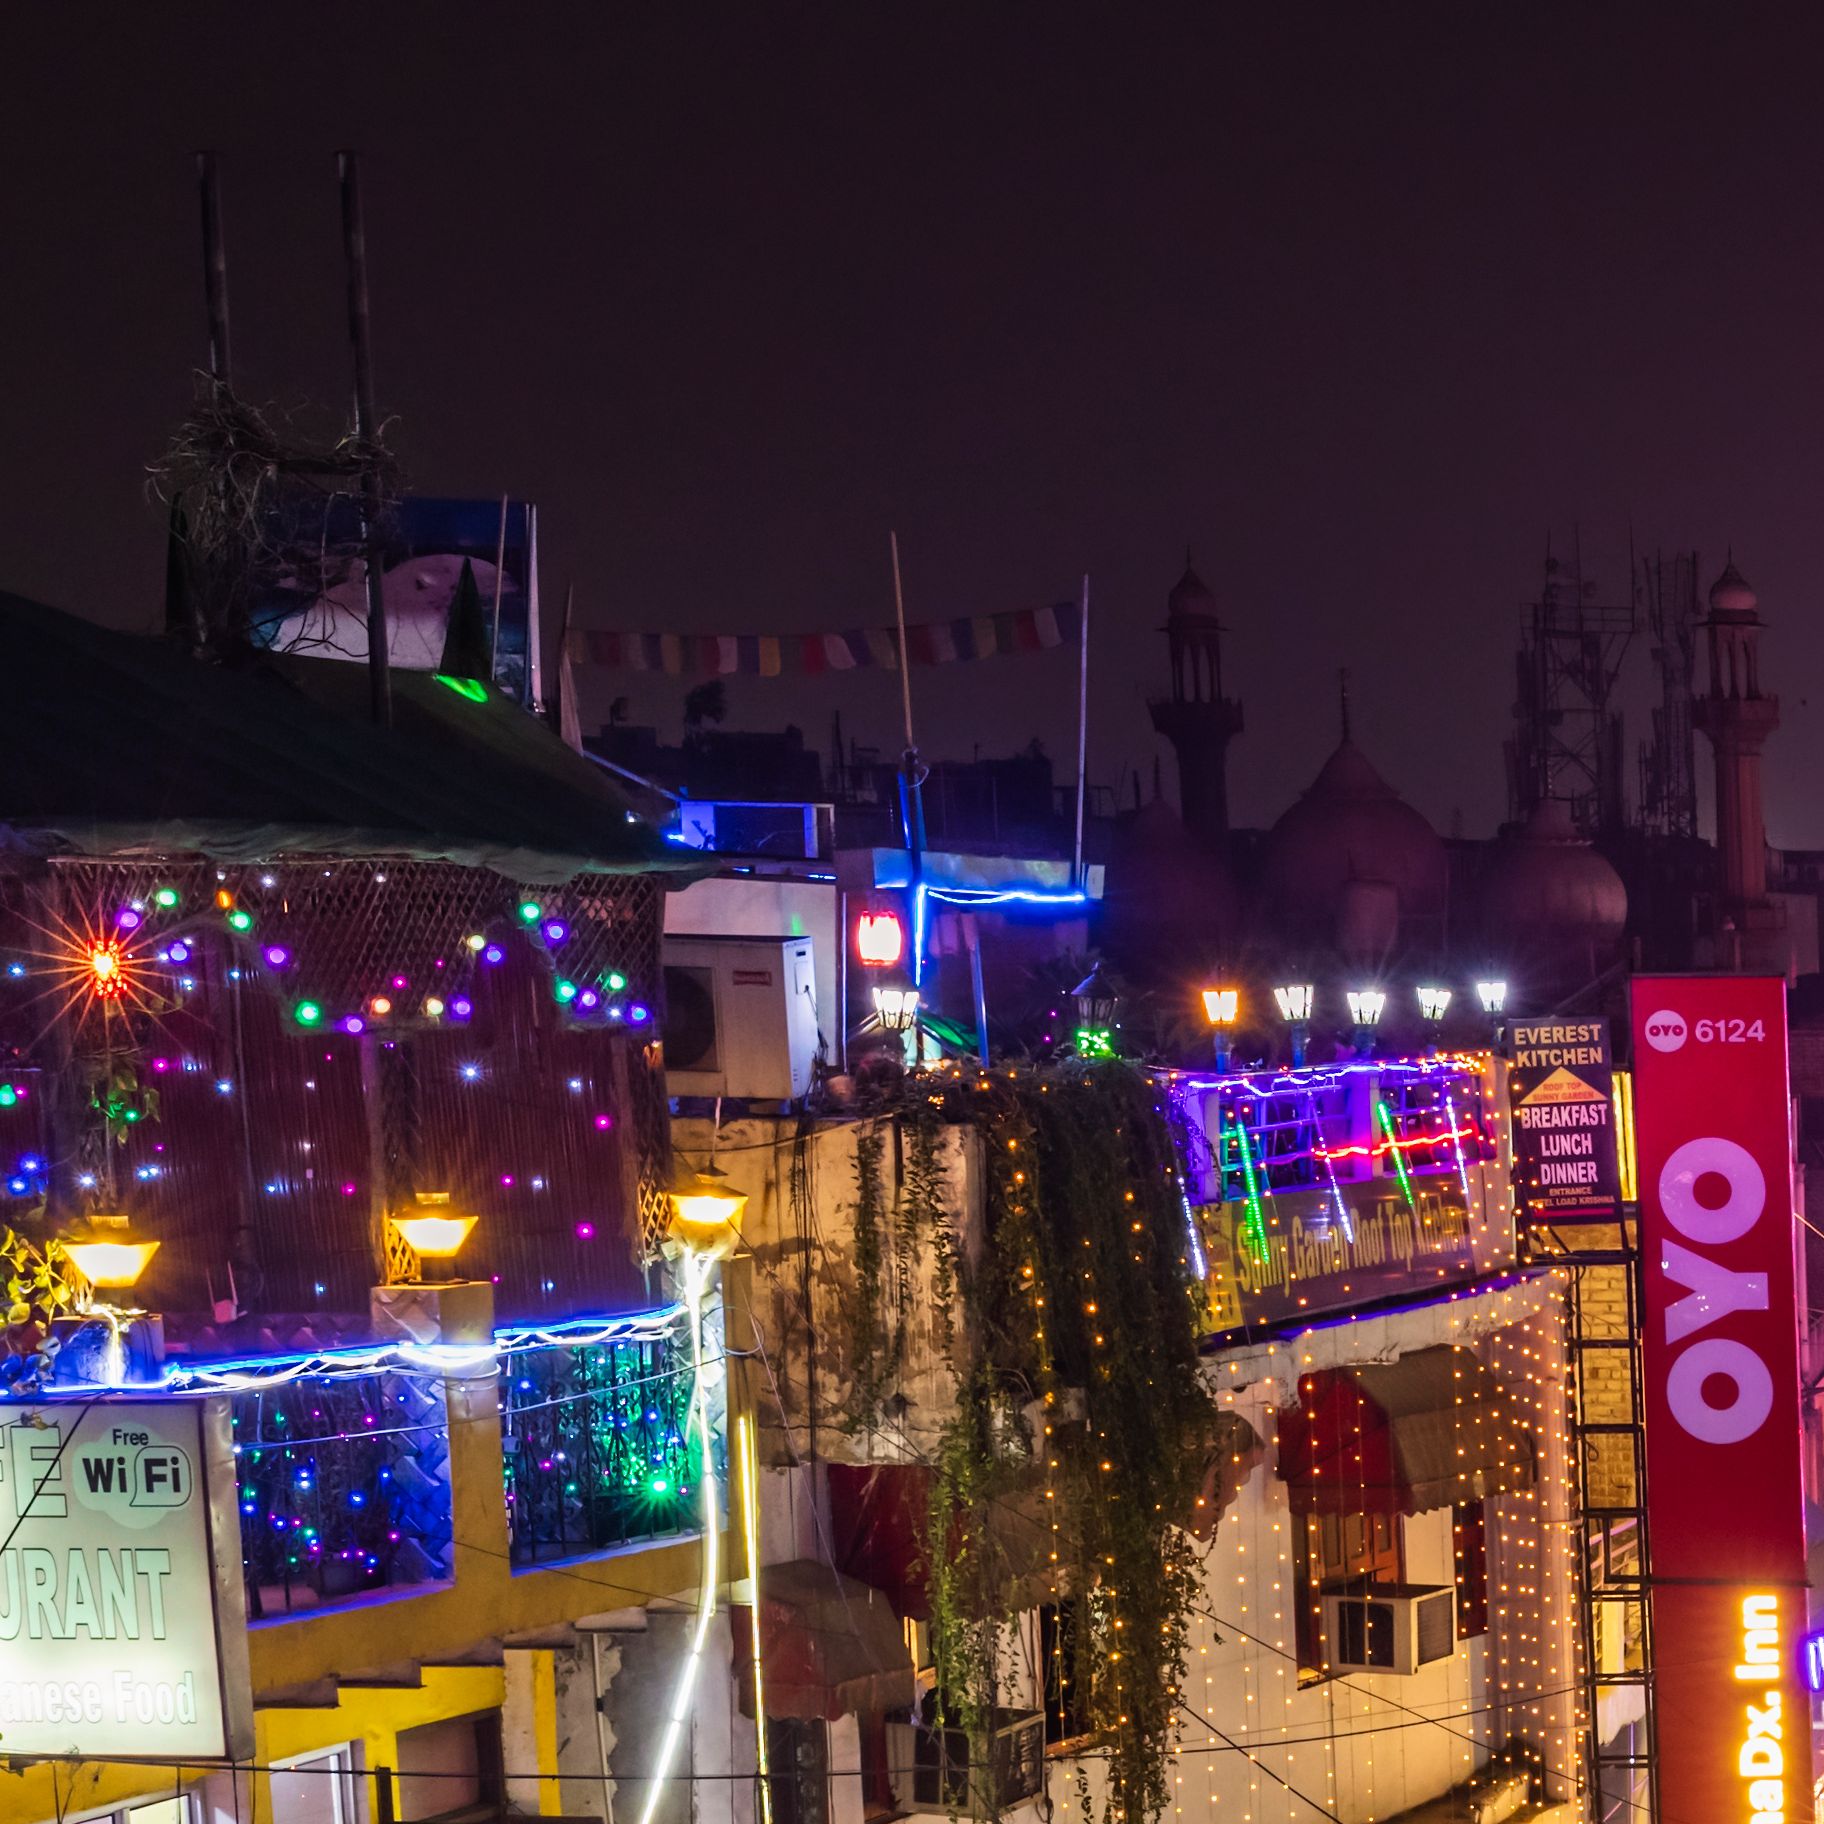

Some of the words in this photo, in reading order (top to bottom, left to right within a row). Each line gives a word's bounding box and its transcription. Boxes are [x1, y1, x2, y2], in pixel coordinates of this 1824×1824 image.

[1515, 1024, 1601, 1045] EVEREST
[1696, 1020, 1765, 1043] 6124
[1517, 1048, 1603, 1067] KITCHEN
[1521, 1104, 1607, 1129] BREAKFAST
[1541, 1134, 1592, 1156] LUNCH
[1541, 1162, 1598, 1184] DINNER
[1352, 1203, 1385, 1268] Roof
[1386, 1202, 1413, 1272] Top
[1660, 1137, 1773, 1444] OYO
[112, 1428, 149, 1446] Free
[1735, 1595, 1779, 1680] Inn
[114, 1671, 197, 1724] Food
